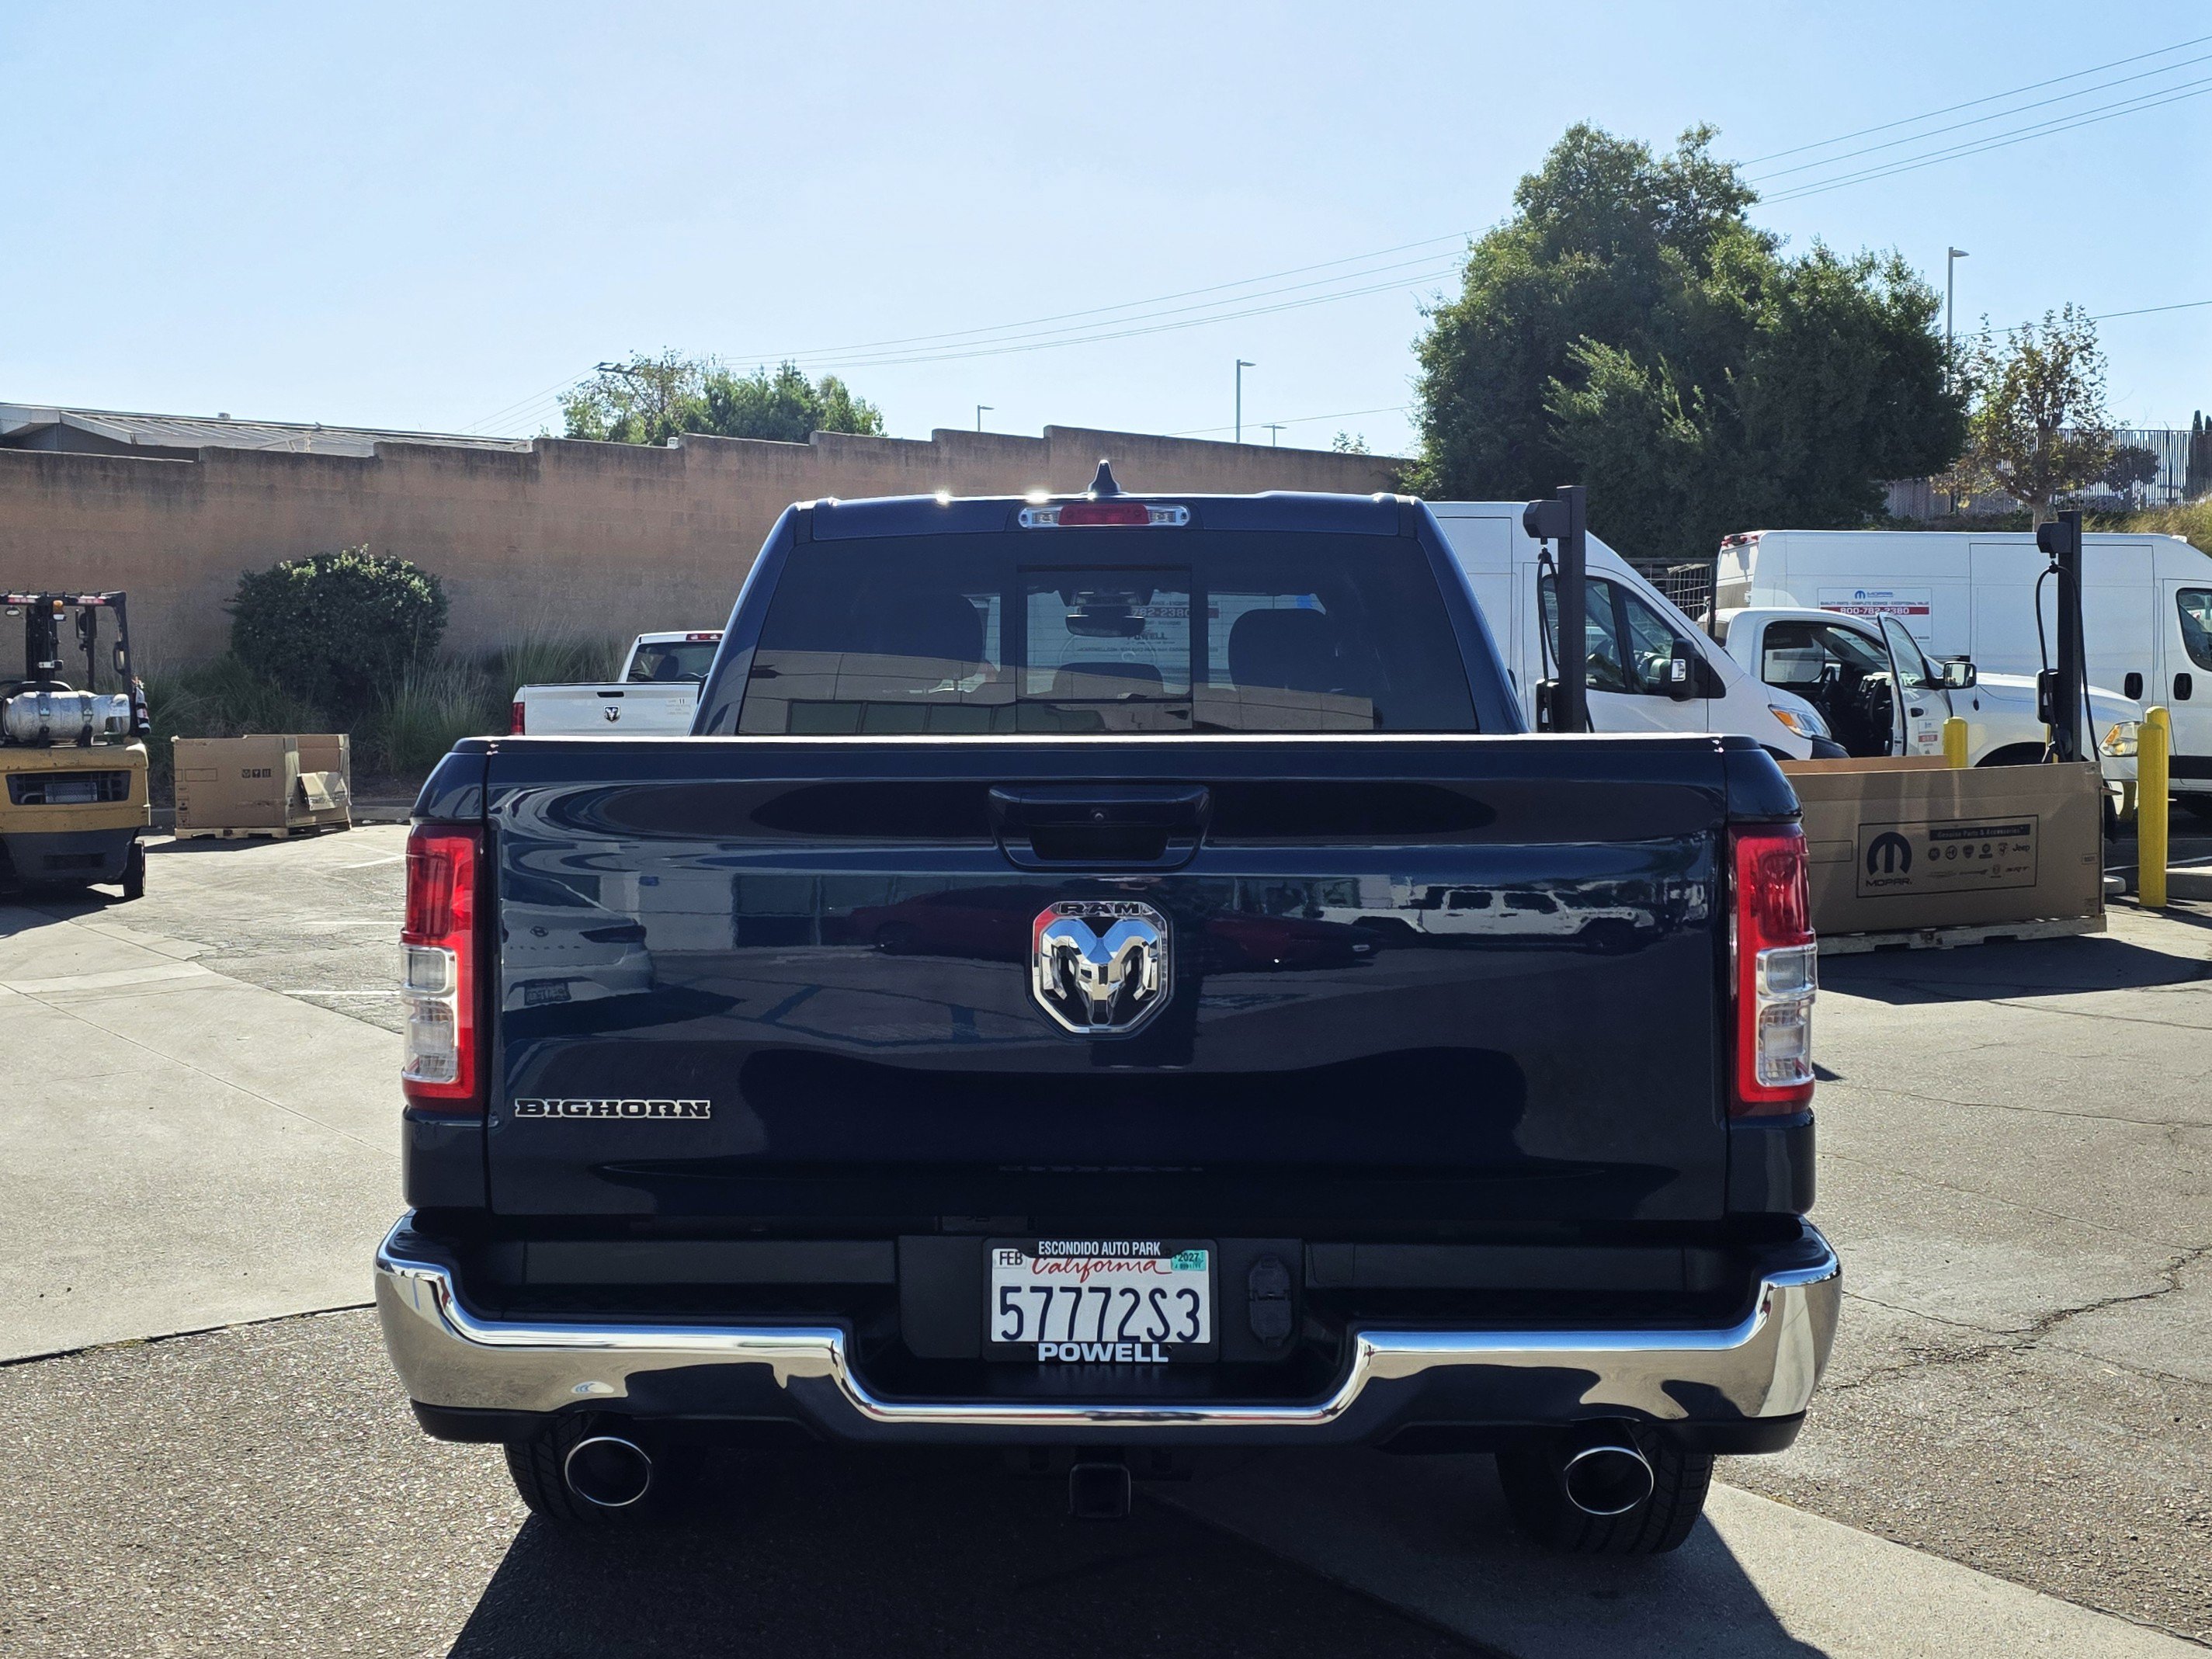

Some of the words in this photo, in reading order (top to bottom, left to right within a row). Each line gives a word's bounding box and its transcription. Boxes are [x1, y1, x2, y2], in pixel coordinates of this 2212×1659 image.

[2012, 843, 2030, 852] Jeep
[1866, 877, 1911, 887] MOPAR
[1059, 903, 1141, 915] RAM
[515, 1098, 710, 1119] BIGHORN
[1038, 1241, 1099, 1256] ESCONDIDO
[1102, 1241, 1130, 1256] AUTO
[1132, 1241, 1161, 1256] PARK
[999, 1251, 1023, 1265] FEB
[1178, 1252, 1200, 1262] 2027
[1032, 1258, 1173, 1283] California
[999, 1286, 1200, 1343] 57772S3
[1038, 1343, 1169, 1363] POWELL
